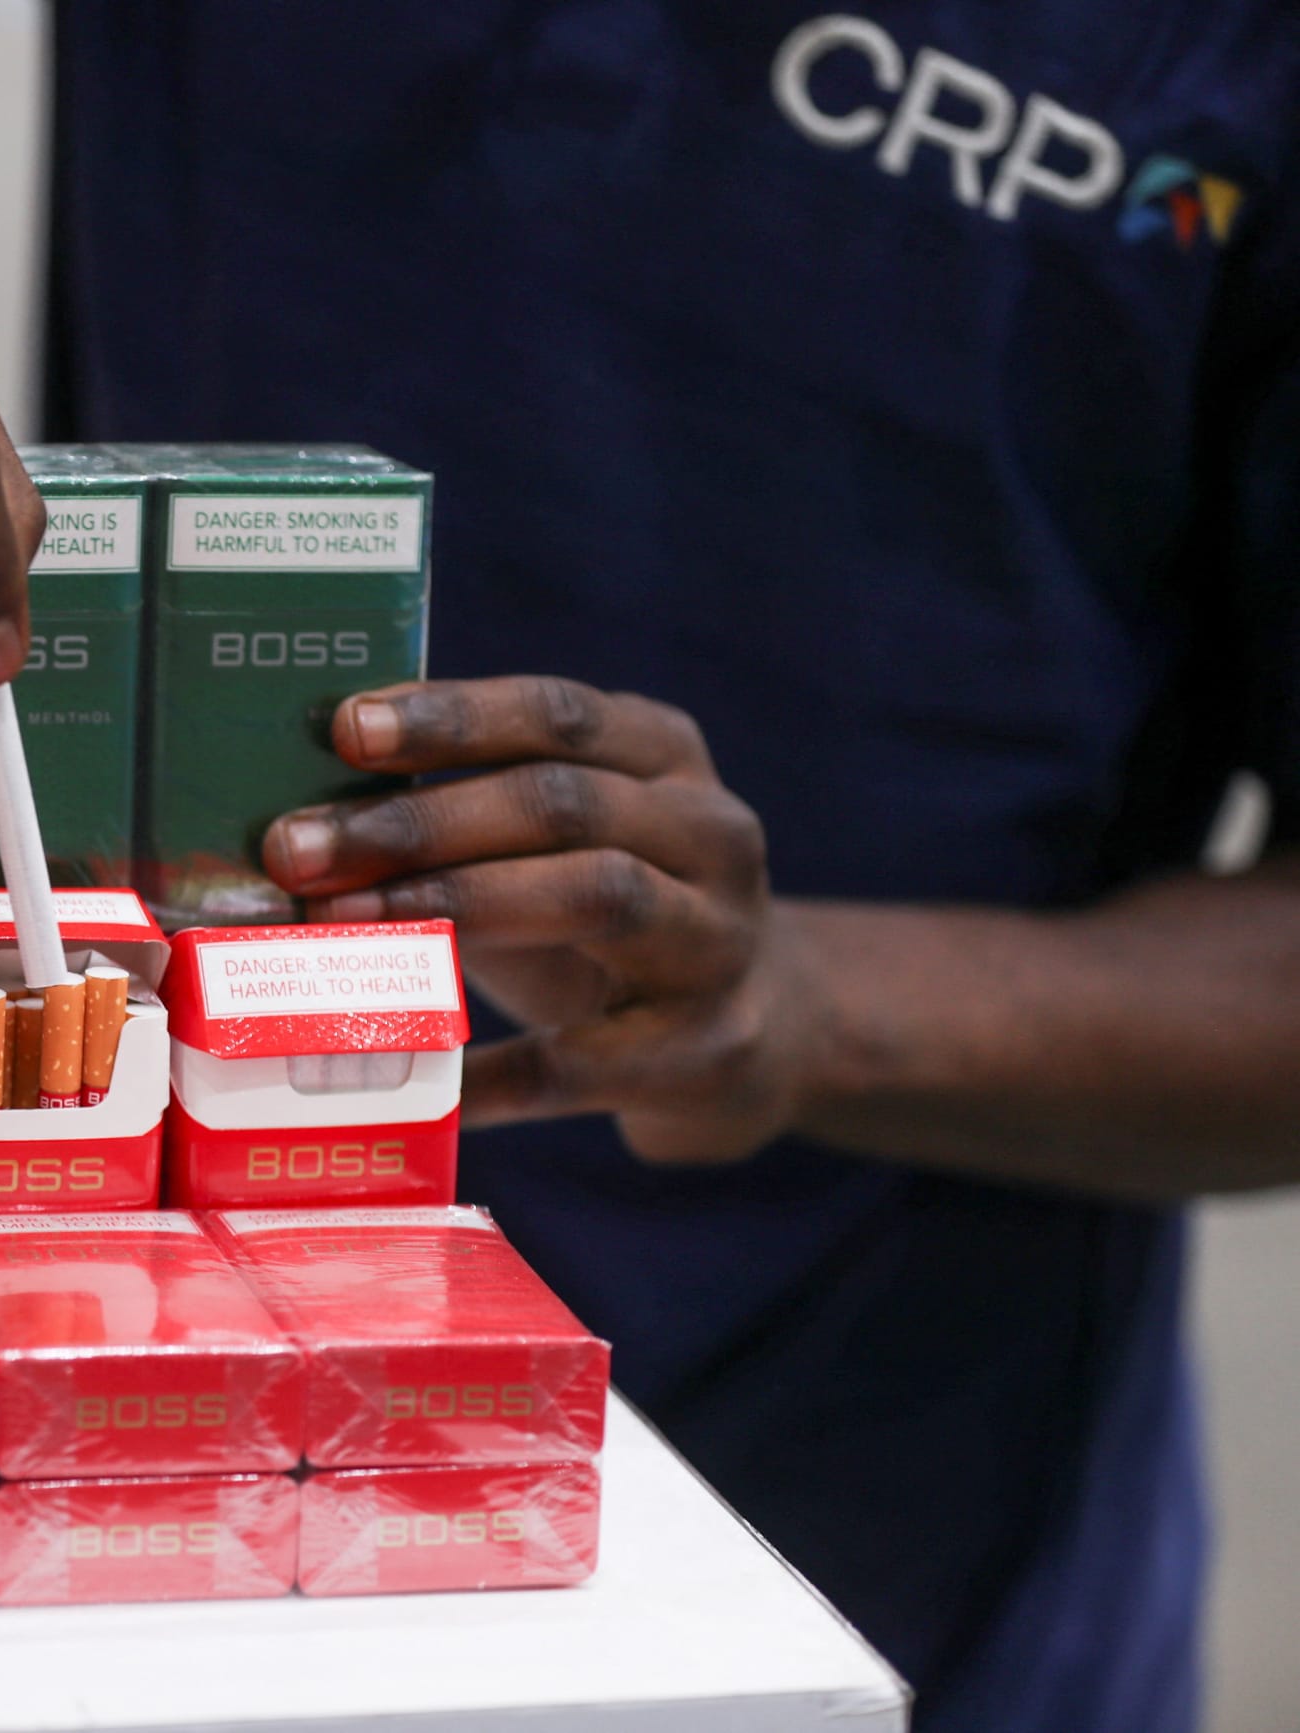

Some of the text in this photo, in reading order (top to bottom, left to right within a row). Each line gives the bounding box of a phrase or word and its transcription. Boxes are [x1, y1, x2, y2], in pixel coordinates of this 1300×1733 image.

[770, 13, 1126, 221] CRP
[47, 513, 117, 531] KING IS
[194, 511, 399, 529] DANGER: SMOKING IS
[41, 537, 114, 554] HEALTH
[196, 535, 396, 553] HARMFUL TO HEALTH
[22, 635, 89, 670] SS
[212, 632, 369, 667] BOSS
[54, 908, 118, 916] EALTH
[225, 952, 430, 977] DANGER: SMOKING IS
[230, 976, 432, 999] HARMFUL TO HEALTH
[248, 1141, 404, 1181] BOSS
[76, 1394, 227, 1429] BOSS
[386, 1385, 534, 1418] BOSS
[68, 1522, 221, 1558] BOSS
[377, 1510, 525, 1547] BOSS
